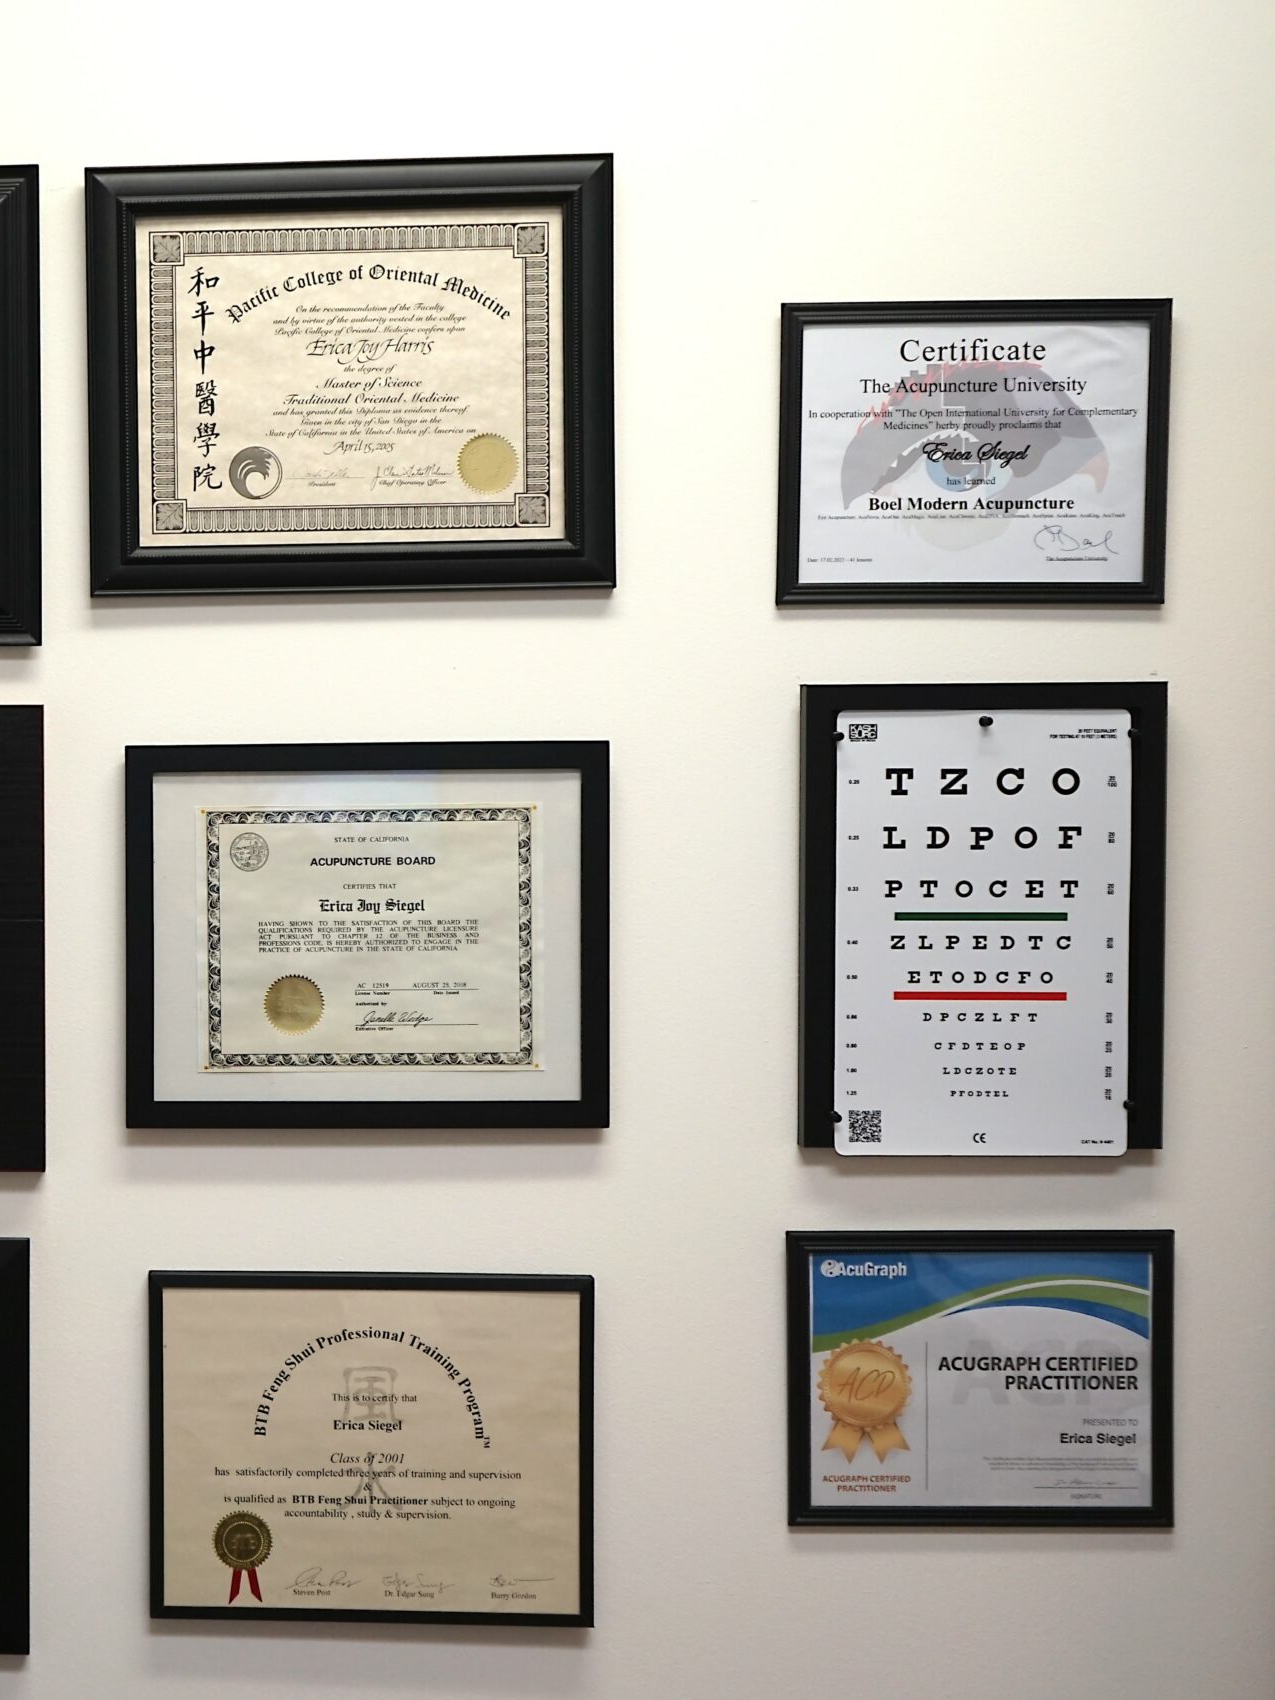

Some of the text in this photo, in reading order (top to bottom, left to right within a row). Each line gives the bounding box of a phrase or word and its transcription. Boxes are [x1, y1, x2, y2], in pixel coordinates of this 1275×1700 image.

[225, 265, 510, 323] Pacific College of Oriental Medicine
[899, 338, 1046, 362] Certificate
[316, 377, 422, 391] Master of Science
[860, 377, 1087, 396] The Acupuncture University
[283, 393, 459, 406] Traditional Oriental Medicine
[809, 409, 817, 418] In
[820, 409, 871, 419] cooperation
[873, 408, 892, 418] with
[919, 408, 943, 419] Open
[946, 407, 1001, 417] International
[1004, 407, 1049, 418] University
[1052, 407, 1065, 416] for
[1067, 407, 1138, 418] Complementary
[923, 441, 1031, 468] Erica Siegel
[869, 497, 1074, 513] Boel Modern Acupuncture
[310, 856, 435, 866] ACUPUNCTURE BOARD
[319, 899, 425, 914] Erica Joy Siegel
[837, 1262, 907, 1278] AcuGraph
[938, 1357, 1138, 1371] ACUGRAPH CERTIFIED
[254, 1327, 484, 1440] BTB Feng Shui Professional Training Program
[1005, 1376, 1138, 1390] PRACTITIONER
[333, 1420, 402, 1433] Erica Siegel
[1060, 1433, 1136, 1446] Erica Siegel
[330, 1452, 405, 1466] Class of 2001
[822, 1475, 911, 1483] ACUGRAPH CERTIFIED
